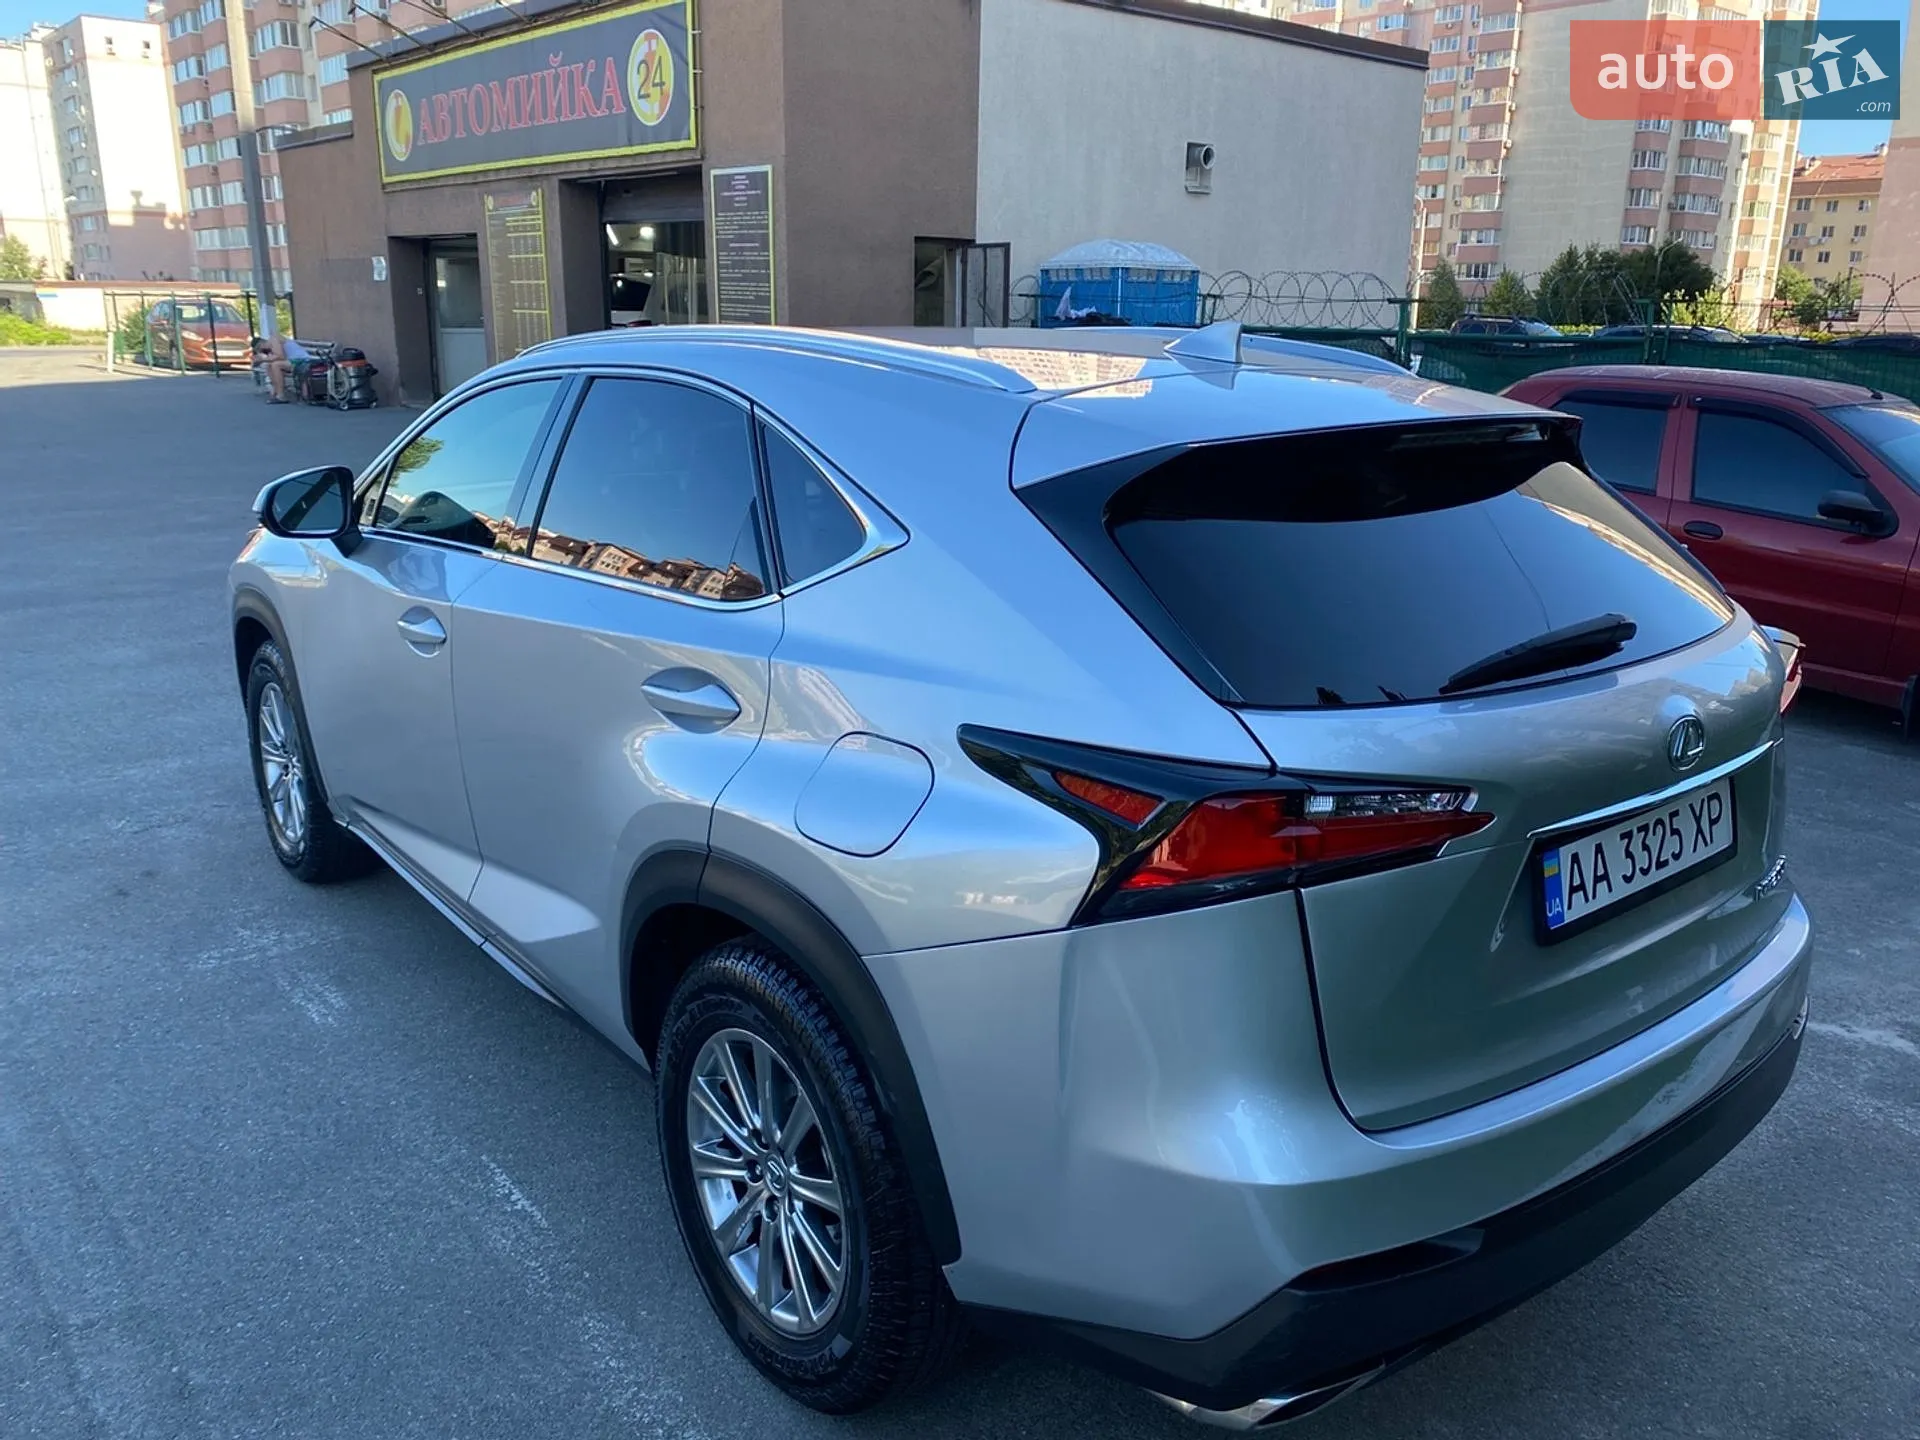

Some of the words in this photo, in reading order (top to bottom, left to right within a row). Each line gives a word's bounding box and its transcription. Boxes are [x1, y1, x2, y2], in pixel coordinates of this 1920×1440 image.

[417, 51, 627, 145] АВТОМИЙКА
[636, 55, 667, 100] 24
[1567, 843, 1614, 911] AA
[1619, 808, 1684, 885] 3325
[1687, 791, 1723, 854] XP
[1546, 897, 1563, 917] UA
